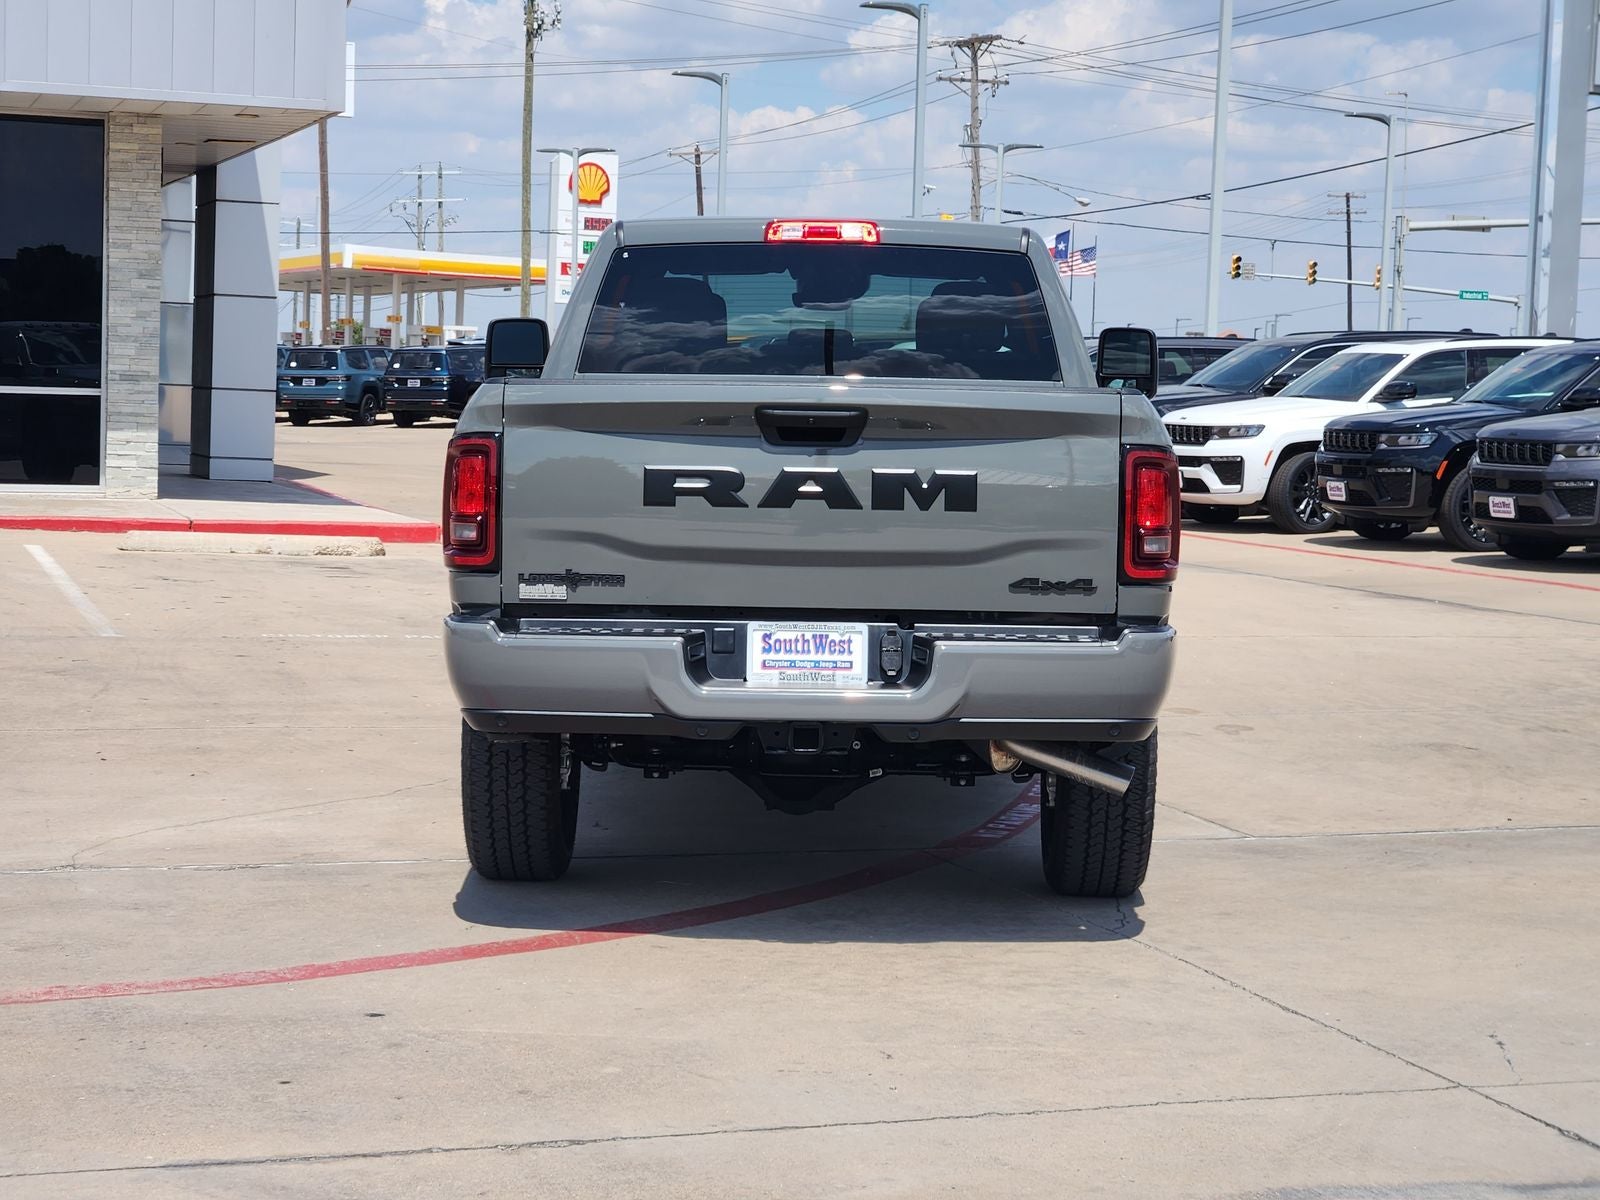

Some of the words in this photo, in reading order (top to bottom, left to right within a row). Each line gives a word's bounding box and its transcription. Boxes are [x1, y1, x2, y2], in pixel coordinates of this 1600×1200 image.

[643, 464, 978, 513] RAM
[761, 632, 853, 656] SouthWest
[765, 660, 790, 668] Chrysler
[795, 660, 815, 668] Dodge
[819, 660, 834, 669] Jeep
[779, 671, 837, 682] SouthWest
